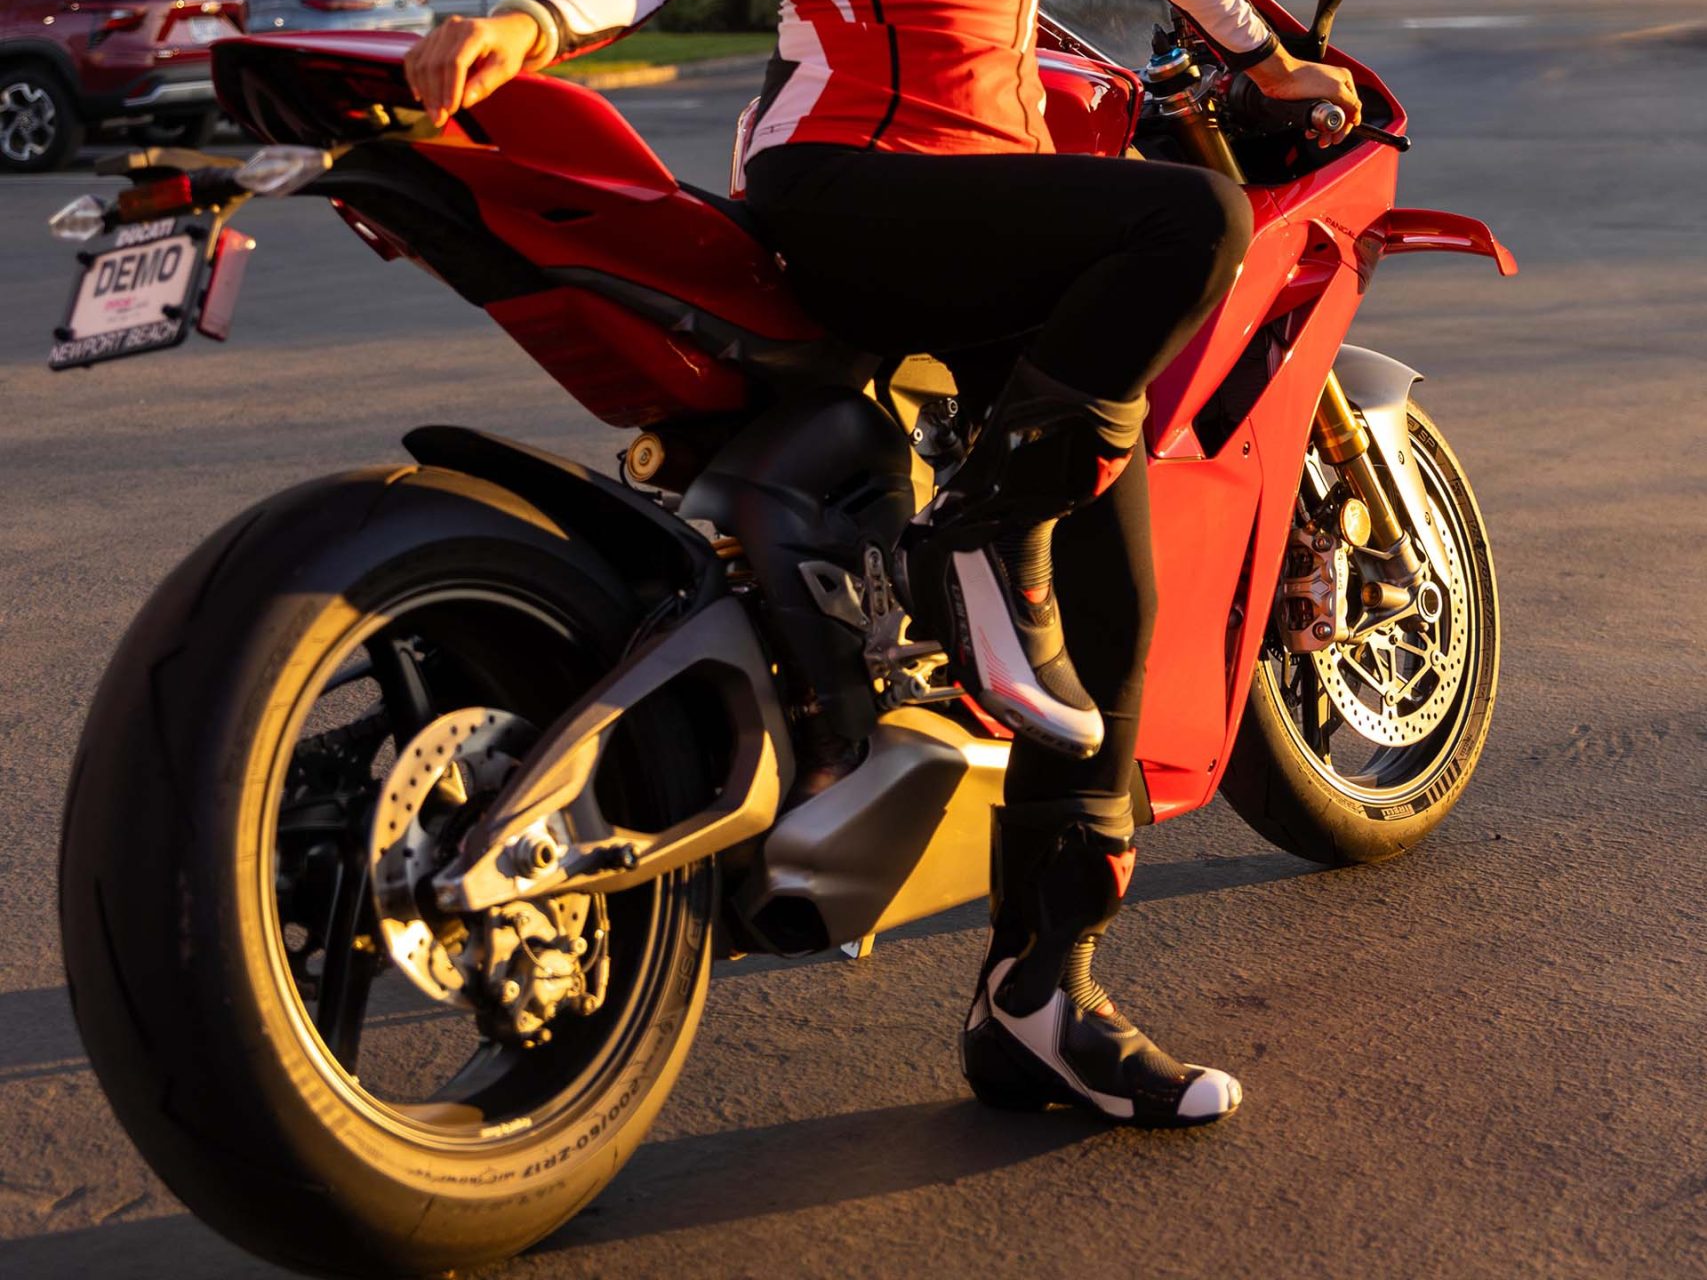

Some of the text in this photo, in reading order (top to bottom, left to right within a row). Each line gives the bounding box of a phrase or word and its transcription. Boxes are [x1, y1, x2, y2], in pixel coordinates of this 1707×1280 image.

[116, 218, 176, 247] DUCATI
[94, 245, 182, 297] DEMO
[49, 319, 183, 363] NEWPORT BEACH
[1418, 429, 1436, 450] SP
[1381, 802, 1416, 821] PIRELLI
